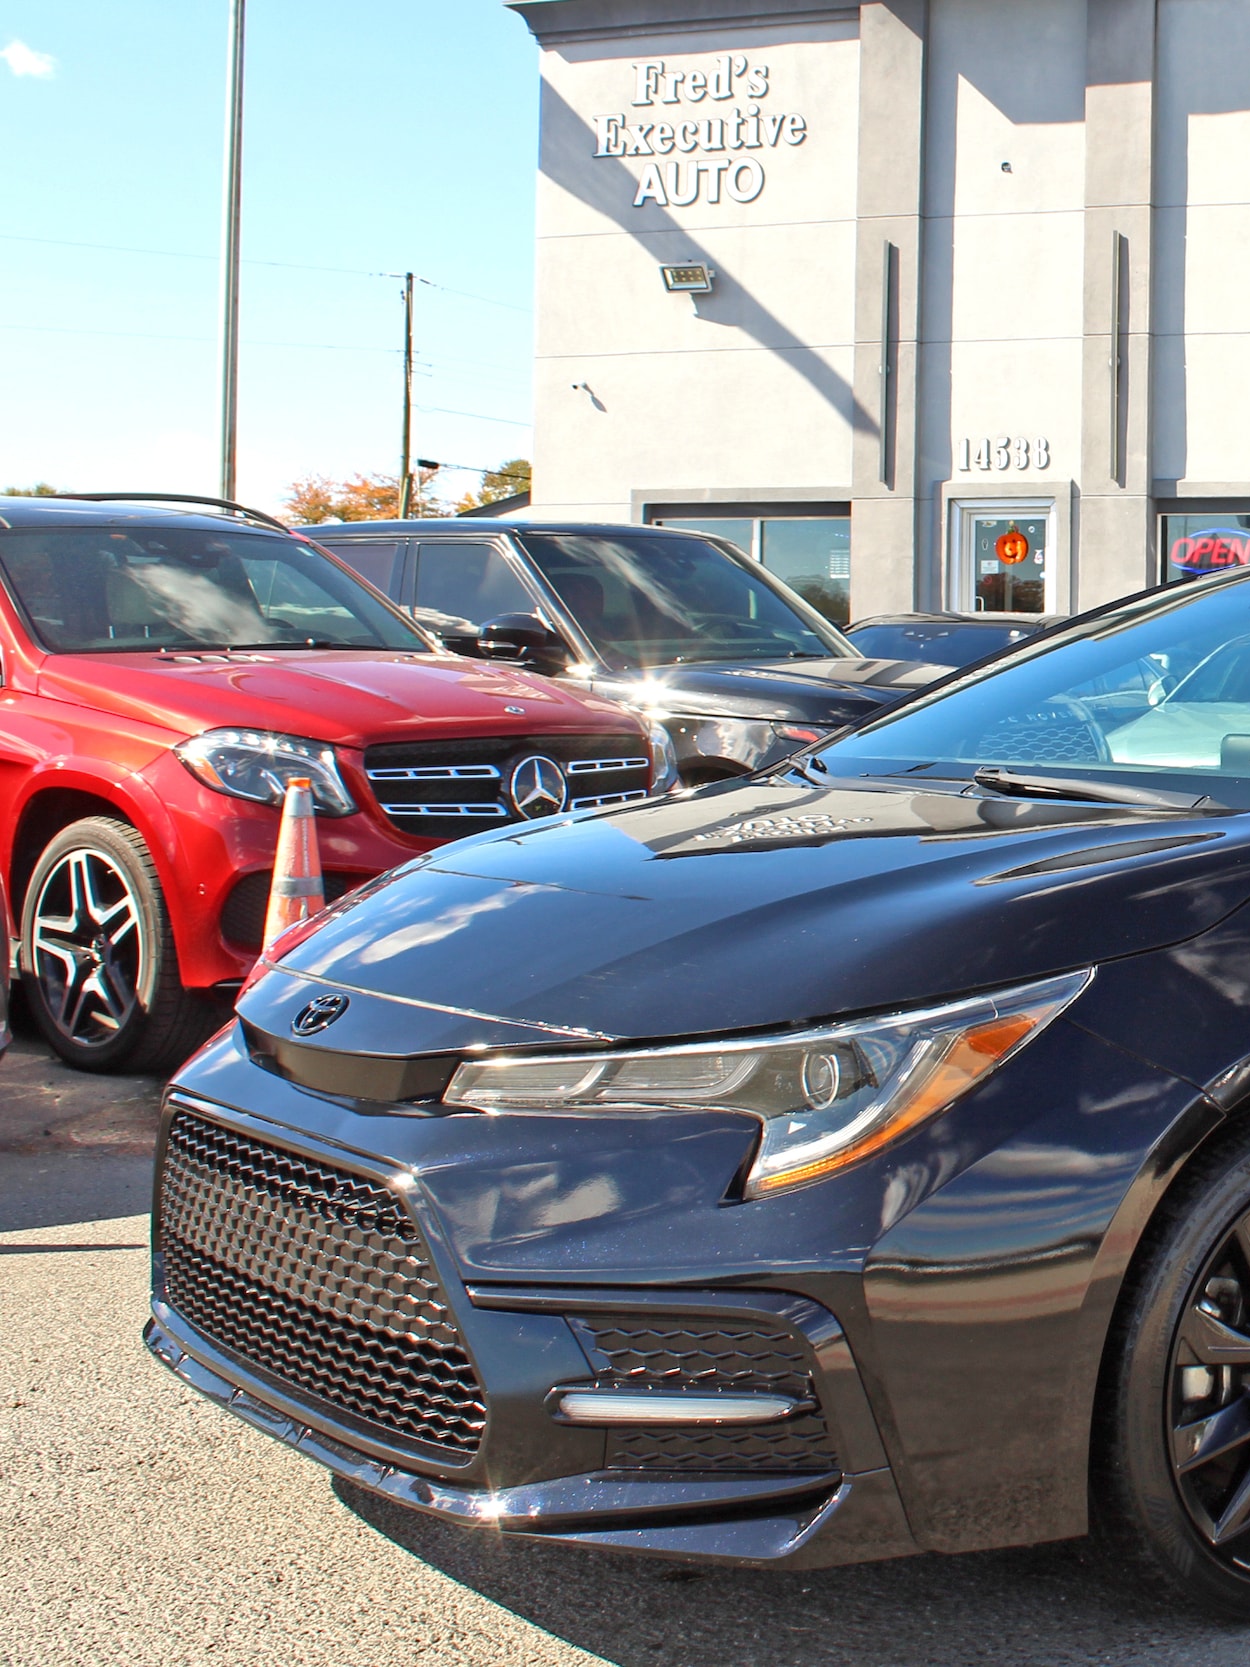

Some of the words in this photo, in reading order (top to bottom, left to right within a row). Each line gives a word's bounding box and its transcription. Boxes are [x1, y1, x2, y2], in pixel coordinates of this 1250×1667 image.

[631, 55, 769, 106] Fred's
[592, 104, 807, 158] Executive
[632, 156, 765, 207] AUTO
[957, 436, 1050, 472] 14538
